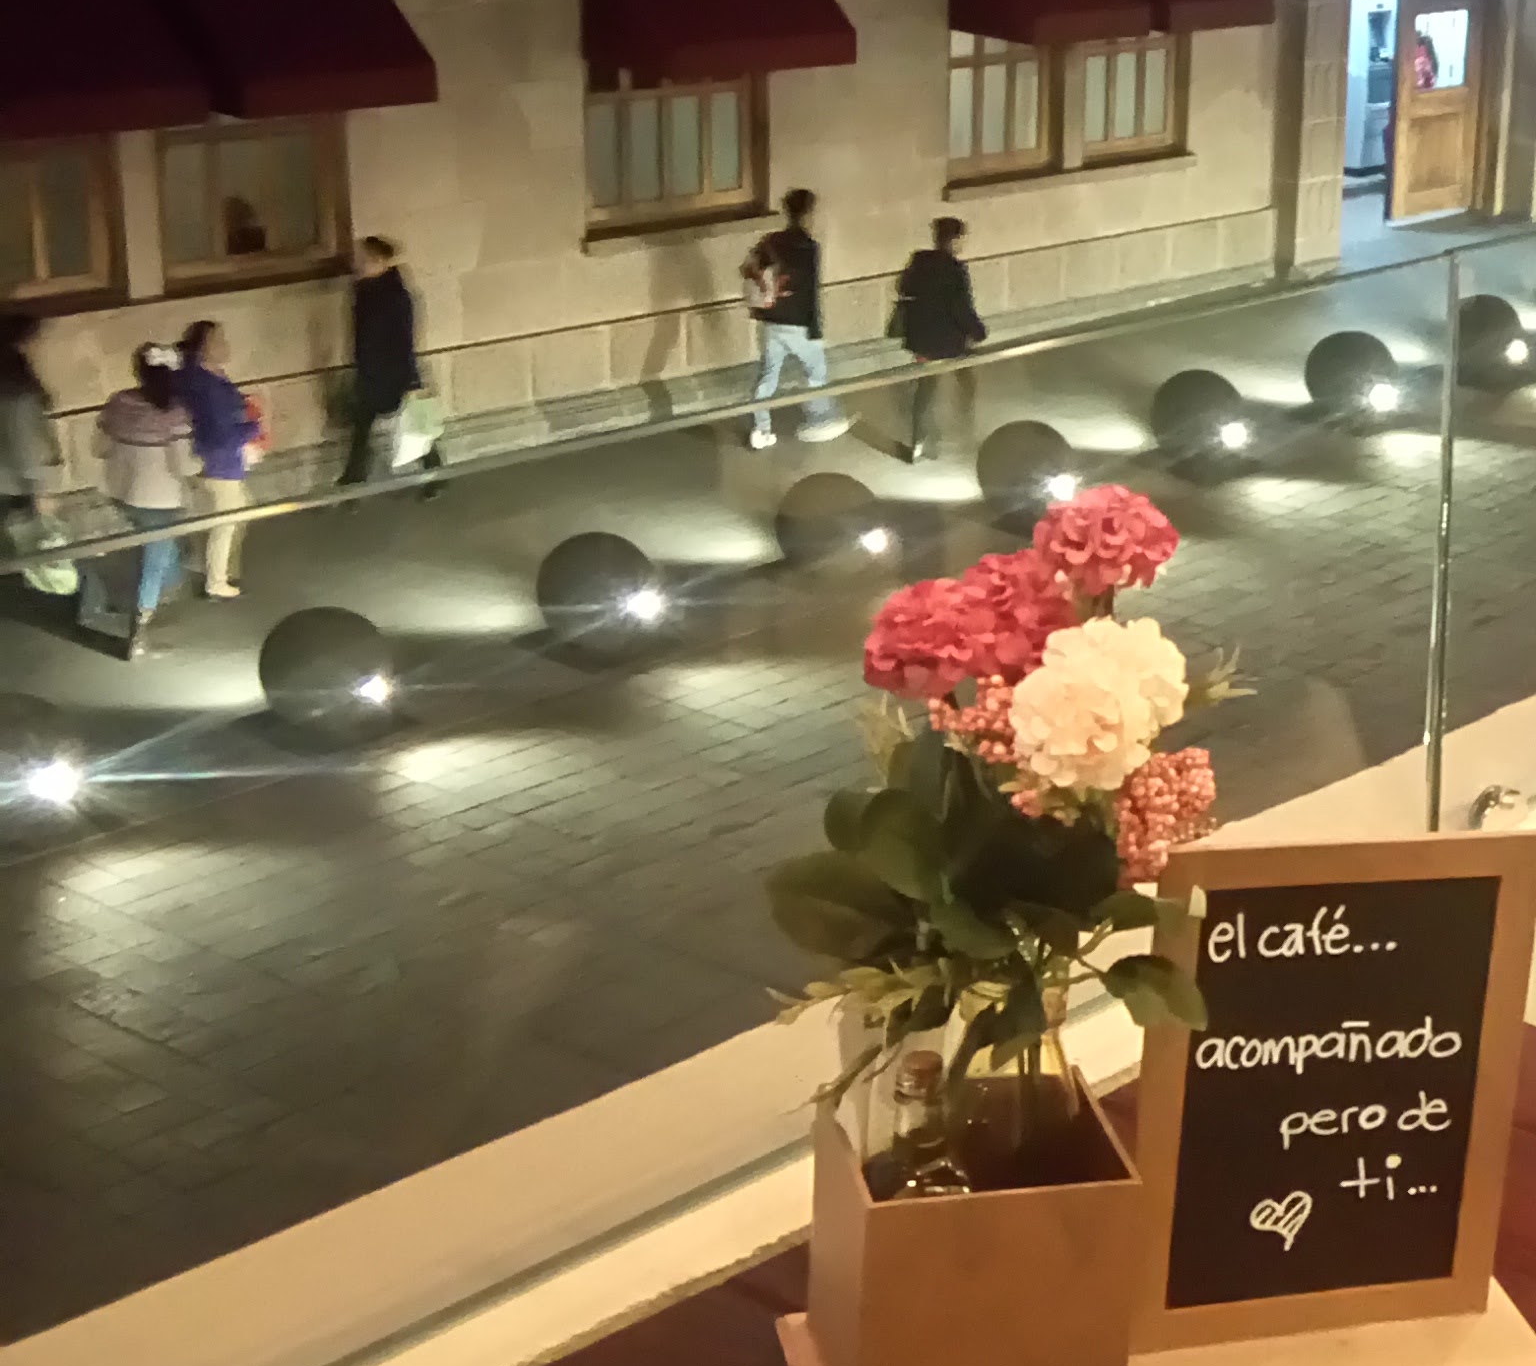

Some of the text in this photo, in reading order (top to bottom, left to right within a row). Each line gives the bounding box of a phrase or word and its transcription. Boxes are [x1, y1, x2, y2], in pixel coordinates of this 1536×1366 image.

[1207, 904, 1398, 963] el café...
[1195, 1016, 1462, 1074] acompañado
[1280, 1091, 1451, 1150] pero de
